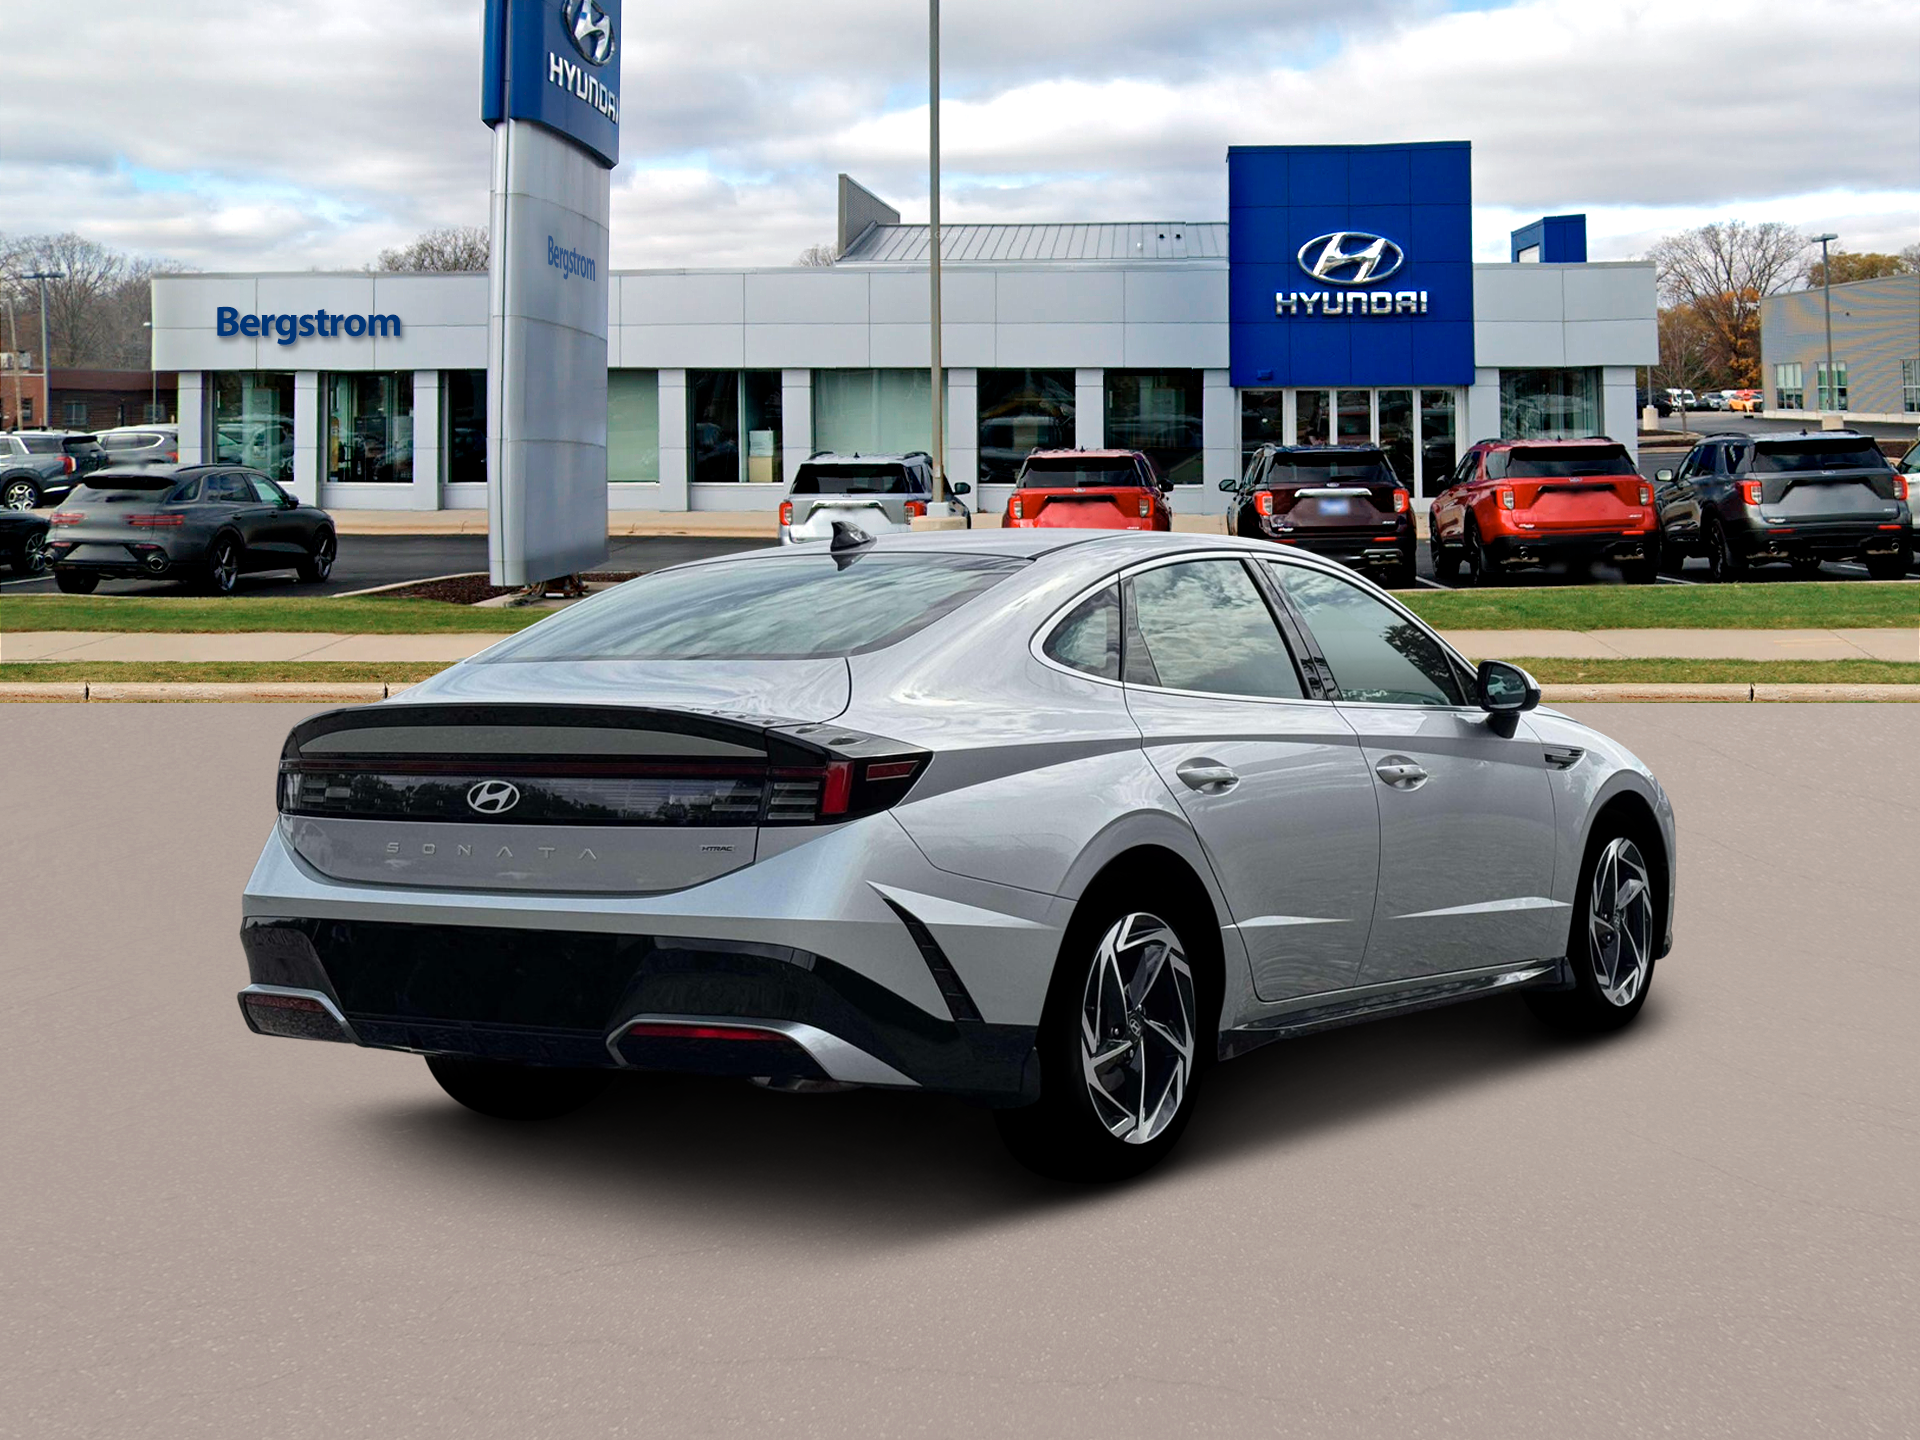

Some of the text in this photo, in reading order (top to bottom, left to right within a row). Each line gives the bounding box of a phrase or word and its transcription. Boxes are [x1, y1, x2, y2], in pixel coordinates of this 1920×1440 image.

[549, 52, 618, 124] HYUNDAI
[548, 235, 595, 282] Bergstrom
[1276, 291, 1428, 315] HYUNDAI
[217, 306, 401, 346] Bergstrom
[387, 842, 598, 860] SONATA
